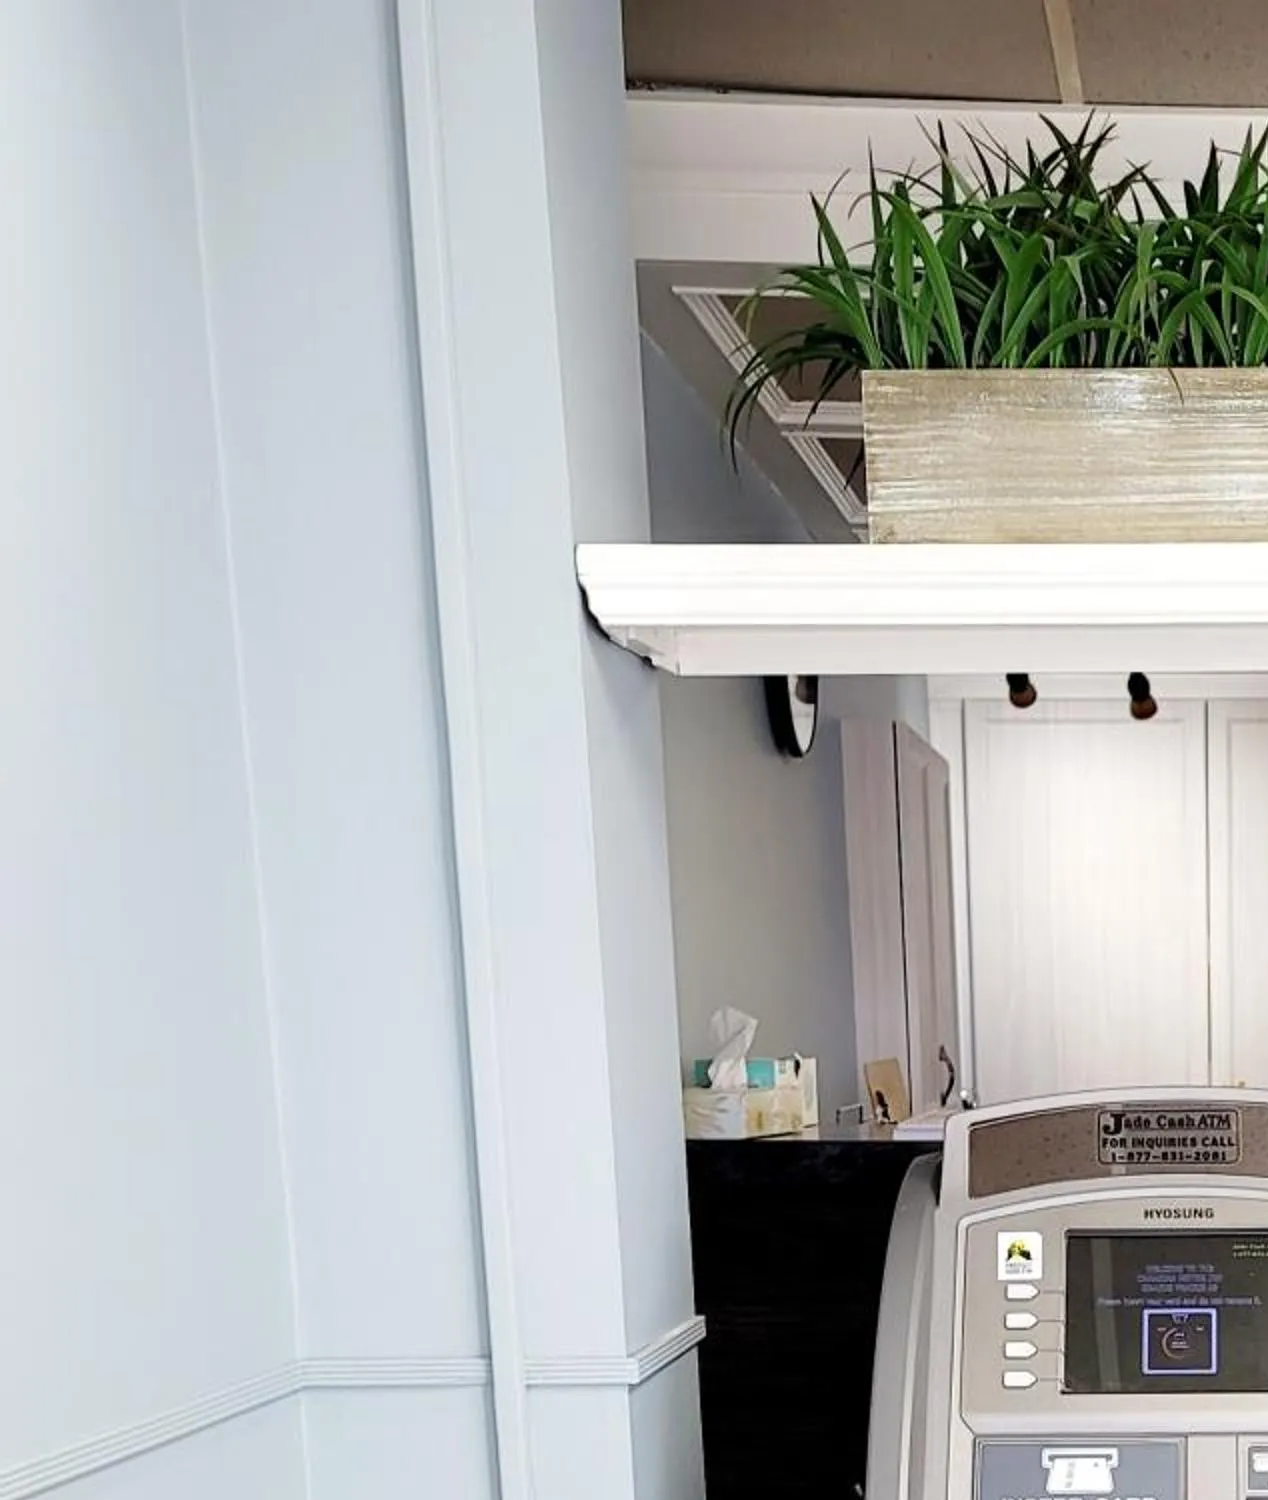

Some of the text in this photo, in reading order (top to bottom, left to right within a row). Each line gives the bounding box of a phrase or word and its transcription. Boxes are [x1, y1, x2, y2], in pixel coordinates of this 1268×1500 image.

[1102, 1113, 1150, 1135] Jade
[1199, 1114, 1231, 1129] ATM
[1101, 1136, 1235, 1149] FOR INQUIRIES CALL
[1143, 1207, 1215, 1219] HYOSUNG
